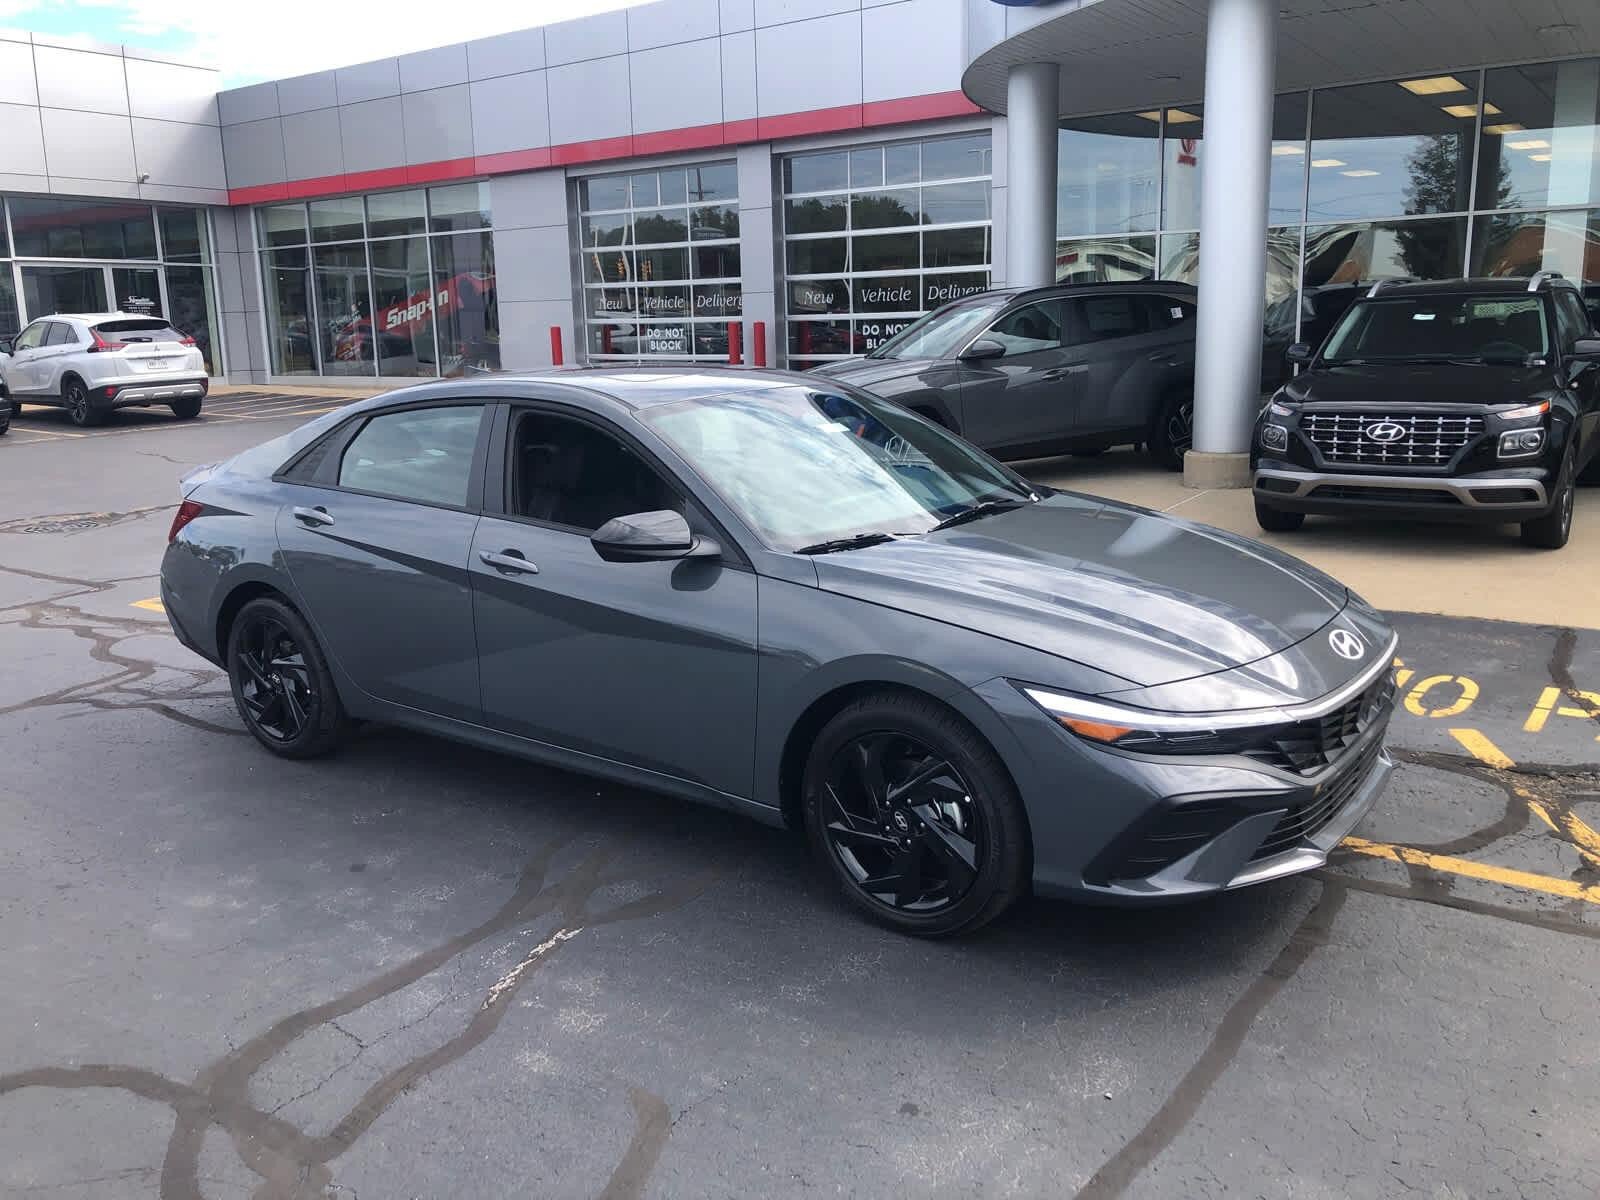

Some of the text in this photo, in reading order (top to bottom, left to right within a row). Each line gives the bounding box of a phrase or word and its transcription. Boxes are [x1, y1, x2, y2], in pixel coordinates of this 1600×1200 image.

[803, 291, 834, 306] New
[861, 287, 912, 303] Vehicle
[599, 296, 623, 311] New
[643, 296, 684, 310] Vehicle
[647, 328, 684, 338] DO NOT
[862, 324, 880, 336] DO
[650, 340, 681, 351] BLOCK
